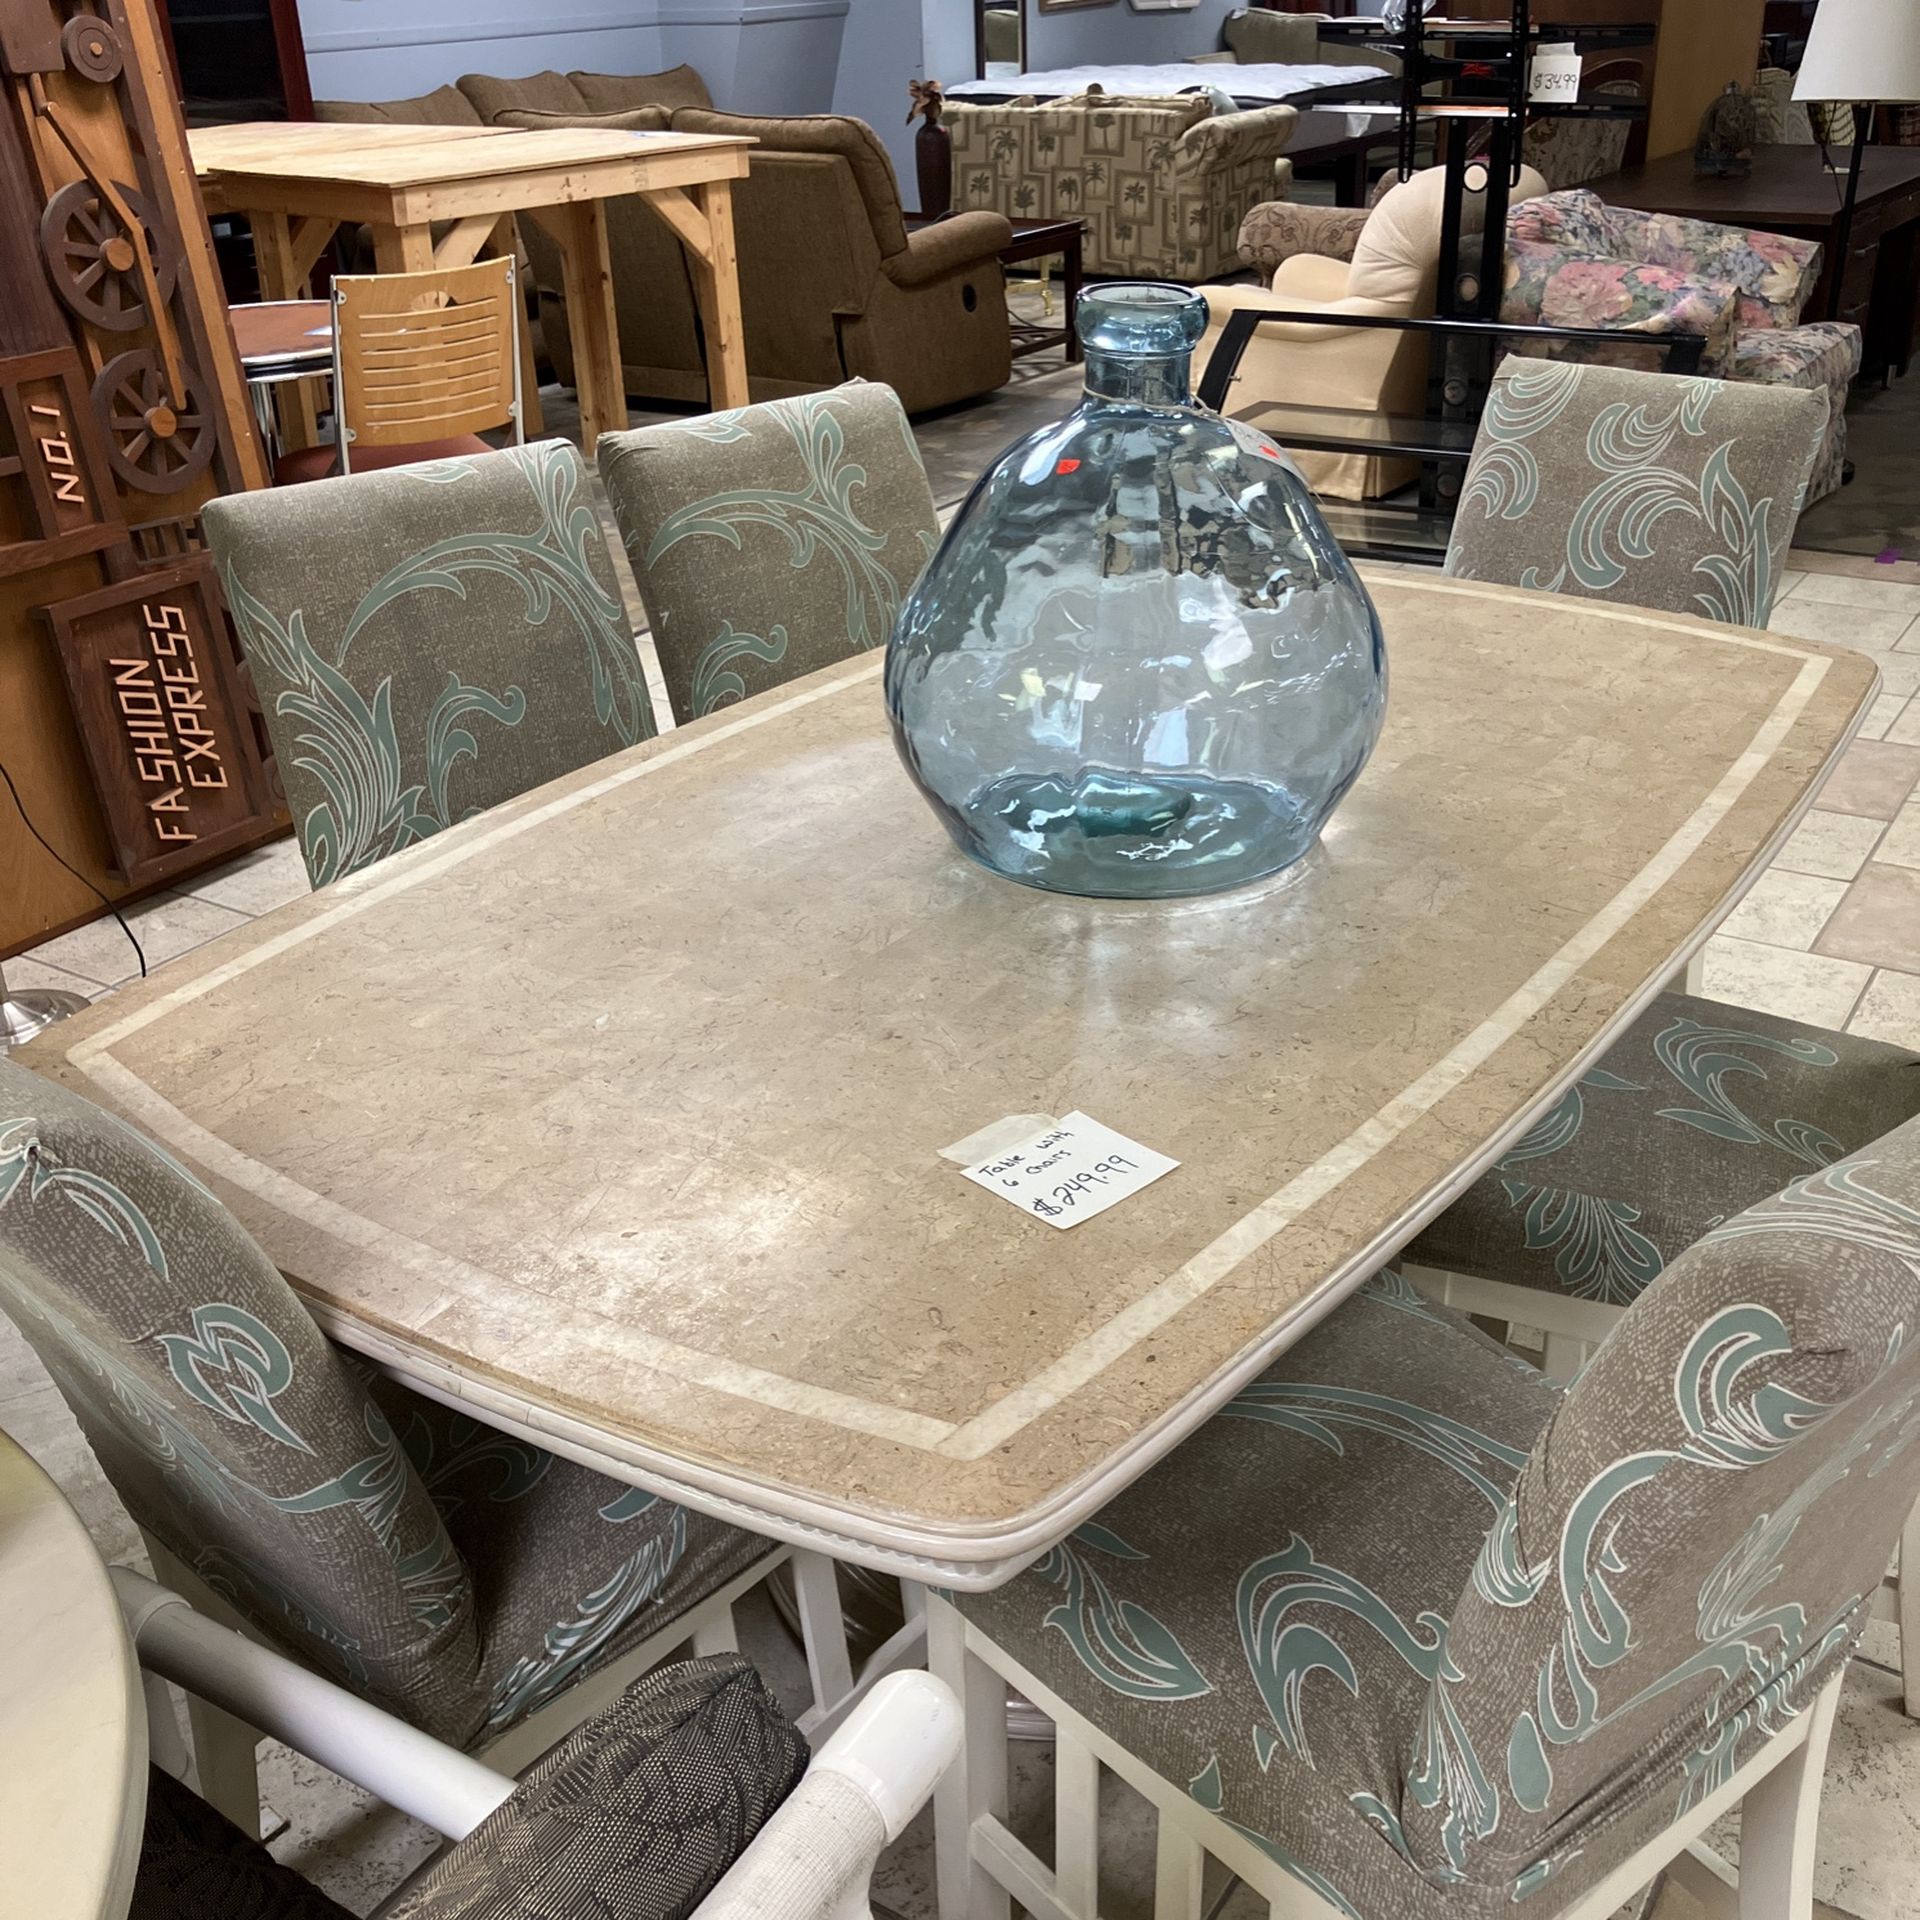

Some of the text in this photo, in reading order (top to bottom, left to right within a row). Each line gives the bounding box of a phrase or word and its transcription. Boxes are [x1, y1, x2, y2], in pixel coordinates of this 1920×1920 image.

[142, 603, 228, 788] EXPRESS
[110, 658, 198, 841] FASHION
[978, 1154, 1026, 1178] Table
[1002, 1178, 1020, 1187] 6
[1033, 1154, 1139, 1216] $249.99
